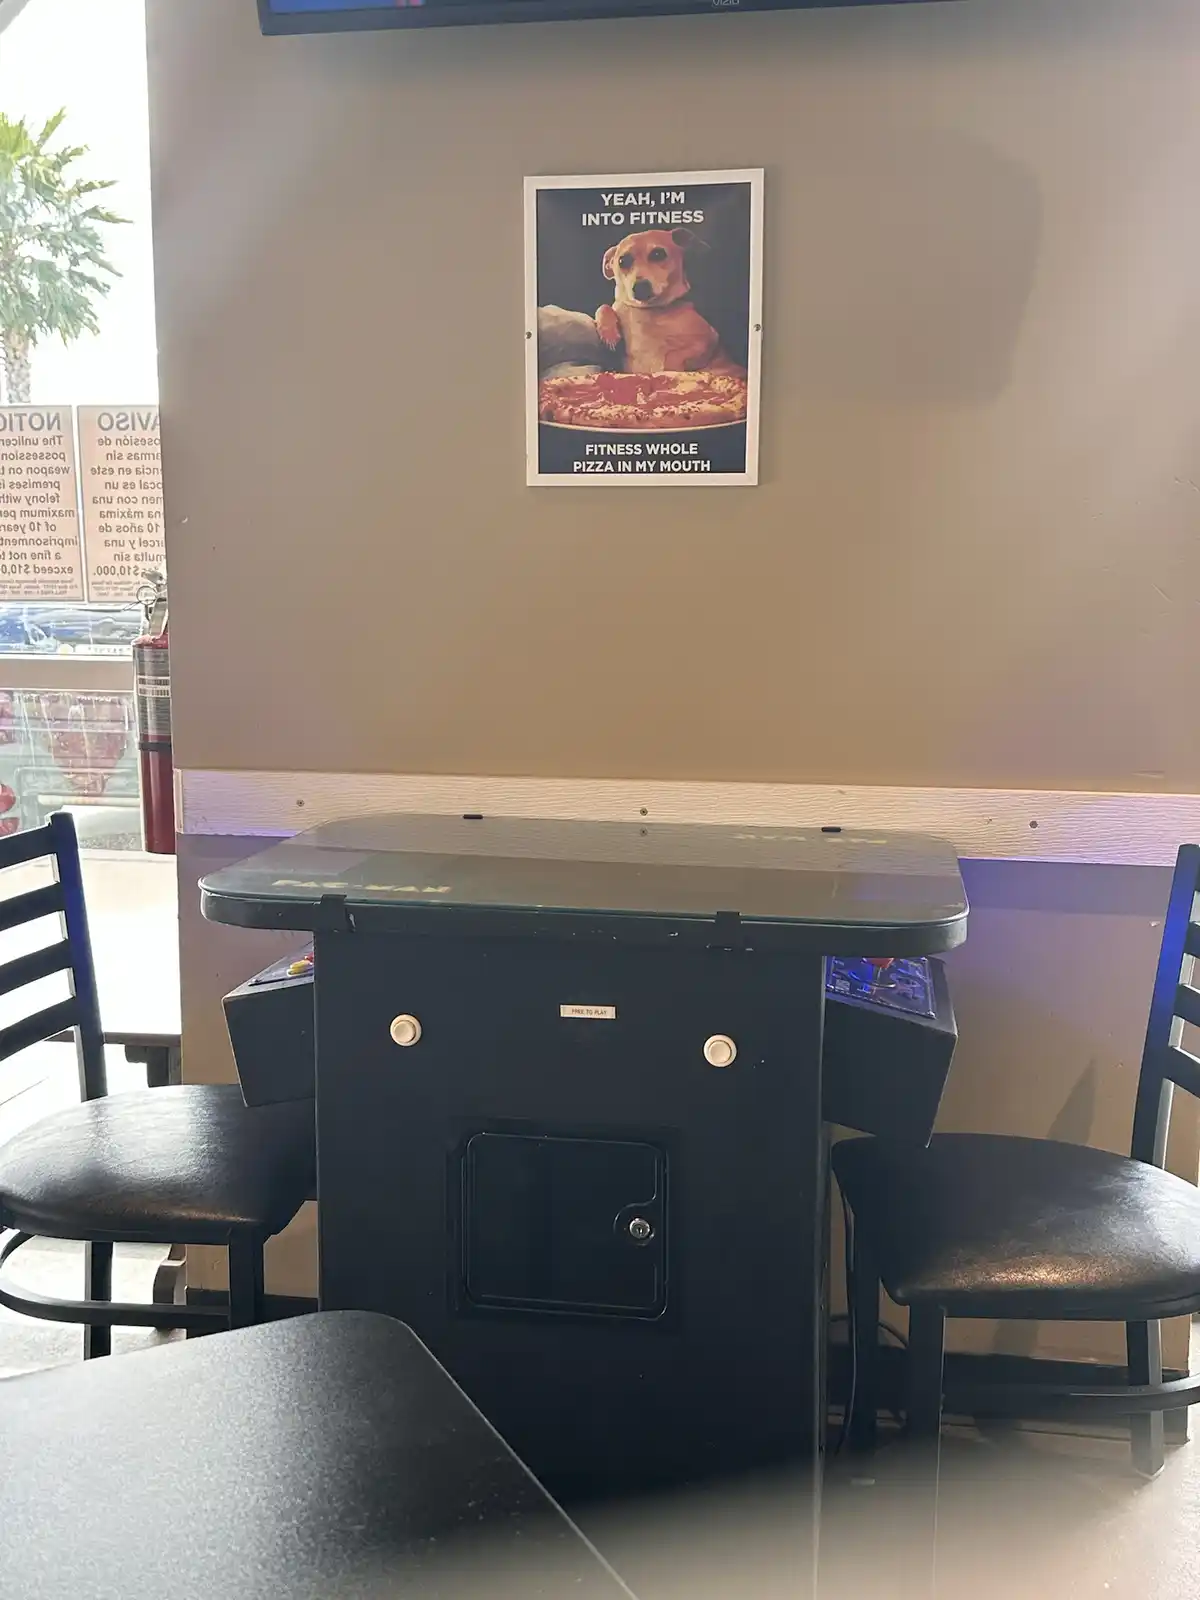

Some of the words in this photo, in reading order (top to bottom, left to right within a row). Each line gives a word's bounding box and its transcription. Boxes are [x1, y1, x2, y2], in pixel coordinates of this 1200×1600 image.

[601, 192, 656, 207] YEAH,
[660, 191, 685, 205] I'M
[581, 212, 625, 226] INTO
[630, 210, 704, 225] FITNESS
[585, 443, 642, 456] FITNESS
[645, 443, 698, 455] WHOLE
[573, 461, 614, 472] PIZZA
[617, 461, 632, 472] IN
[635, 460, 656, 472] MY
[660, 460, 711, 472] MOUTH
